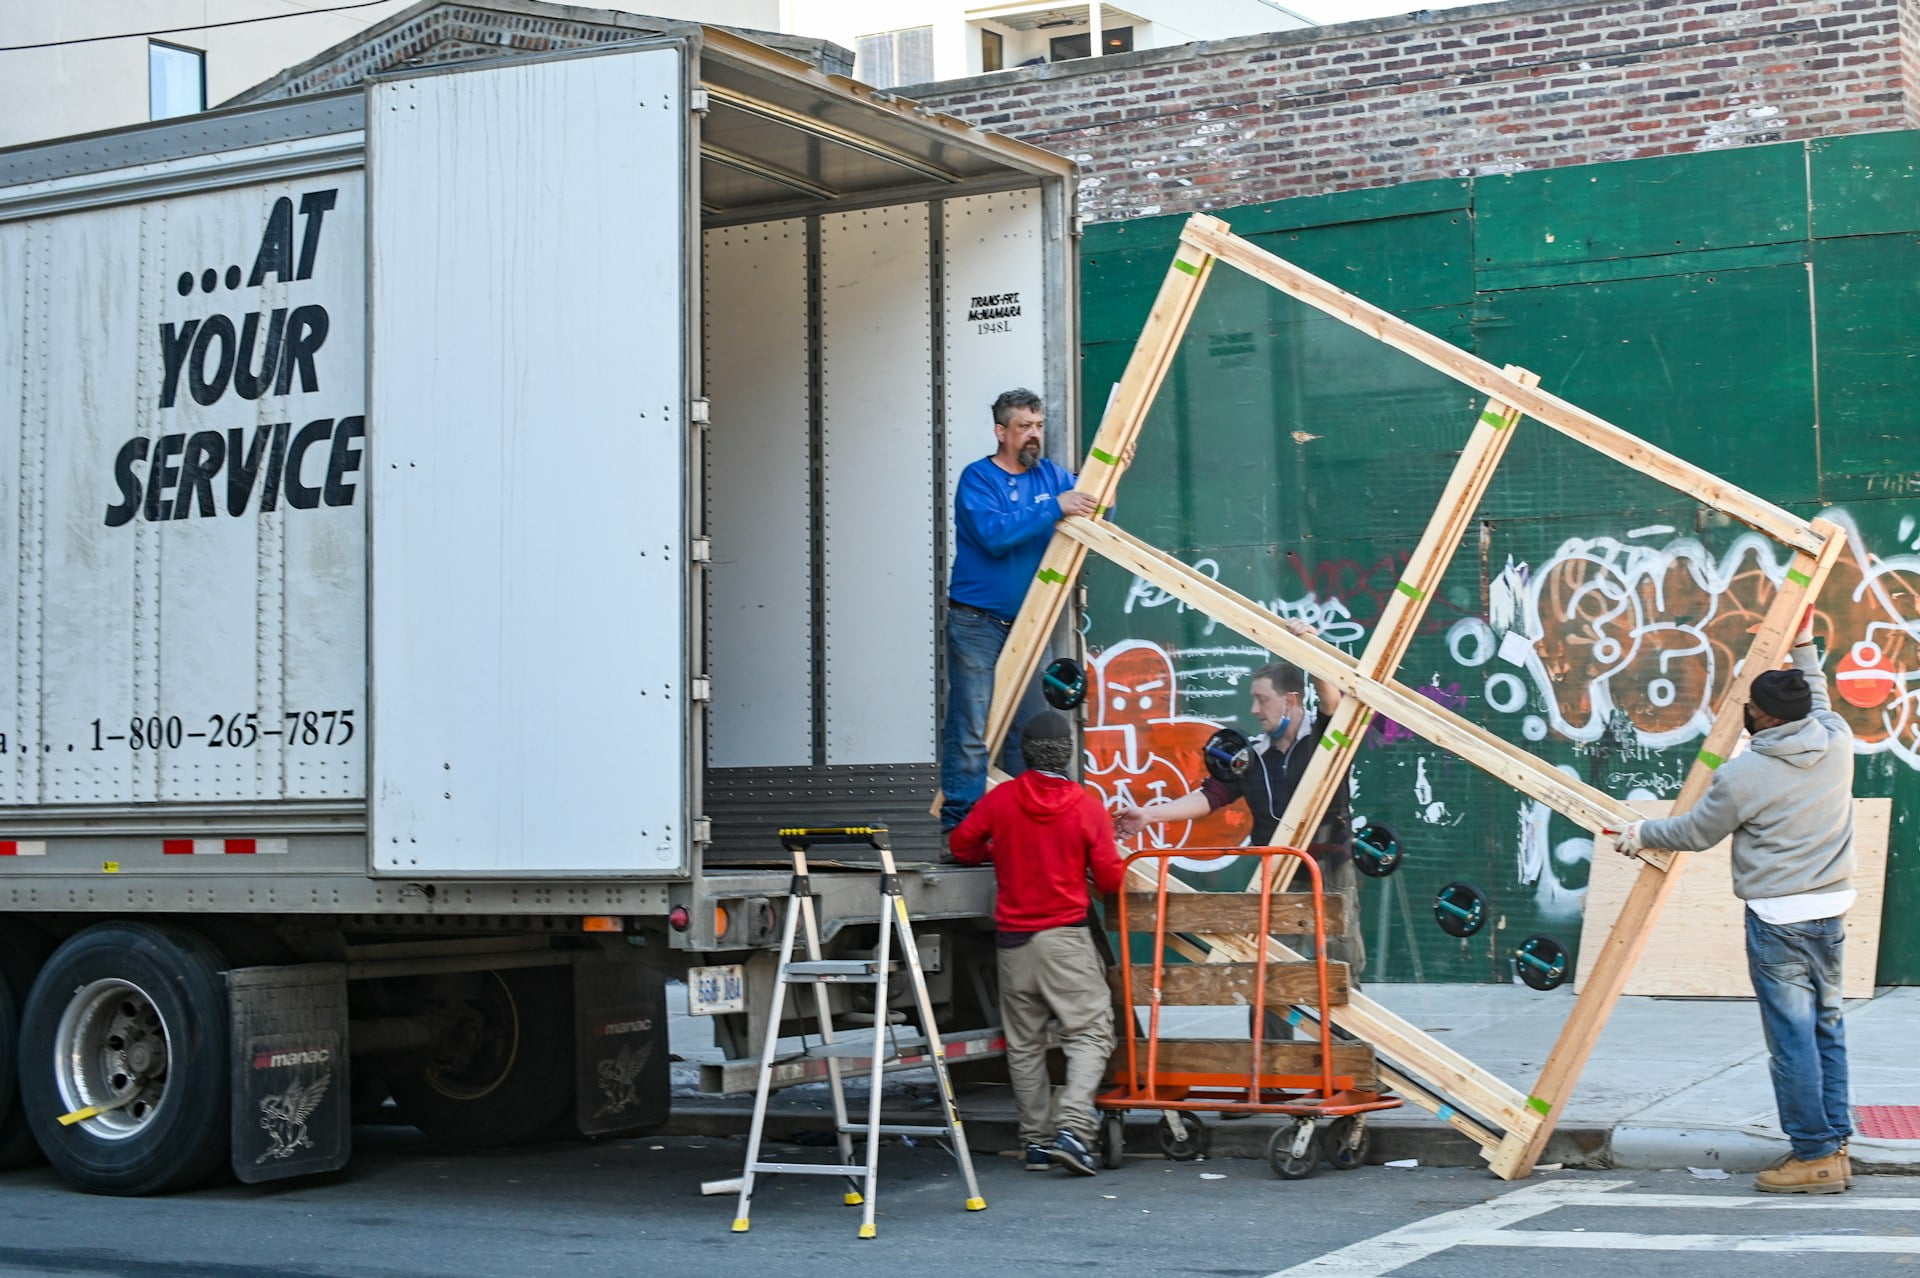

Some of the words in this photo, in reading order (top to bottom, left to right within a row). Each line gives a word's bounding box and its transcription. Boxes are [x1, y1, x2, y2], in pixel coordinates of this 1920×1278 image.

[158, 304, 330, 409] YOUR
[104, 415, 365, 527] SERVICE
[91, 709, 354, 752] 1-800-265-7875
[270, 1049, 330, 1068] manac
